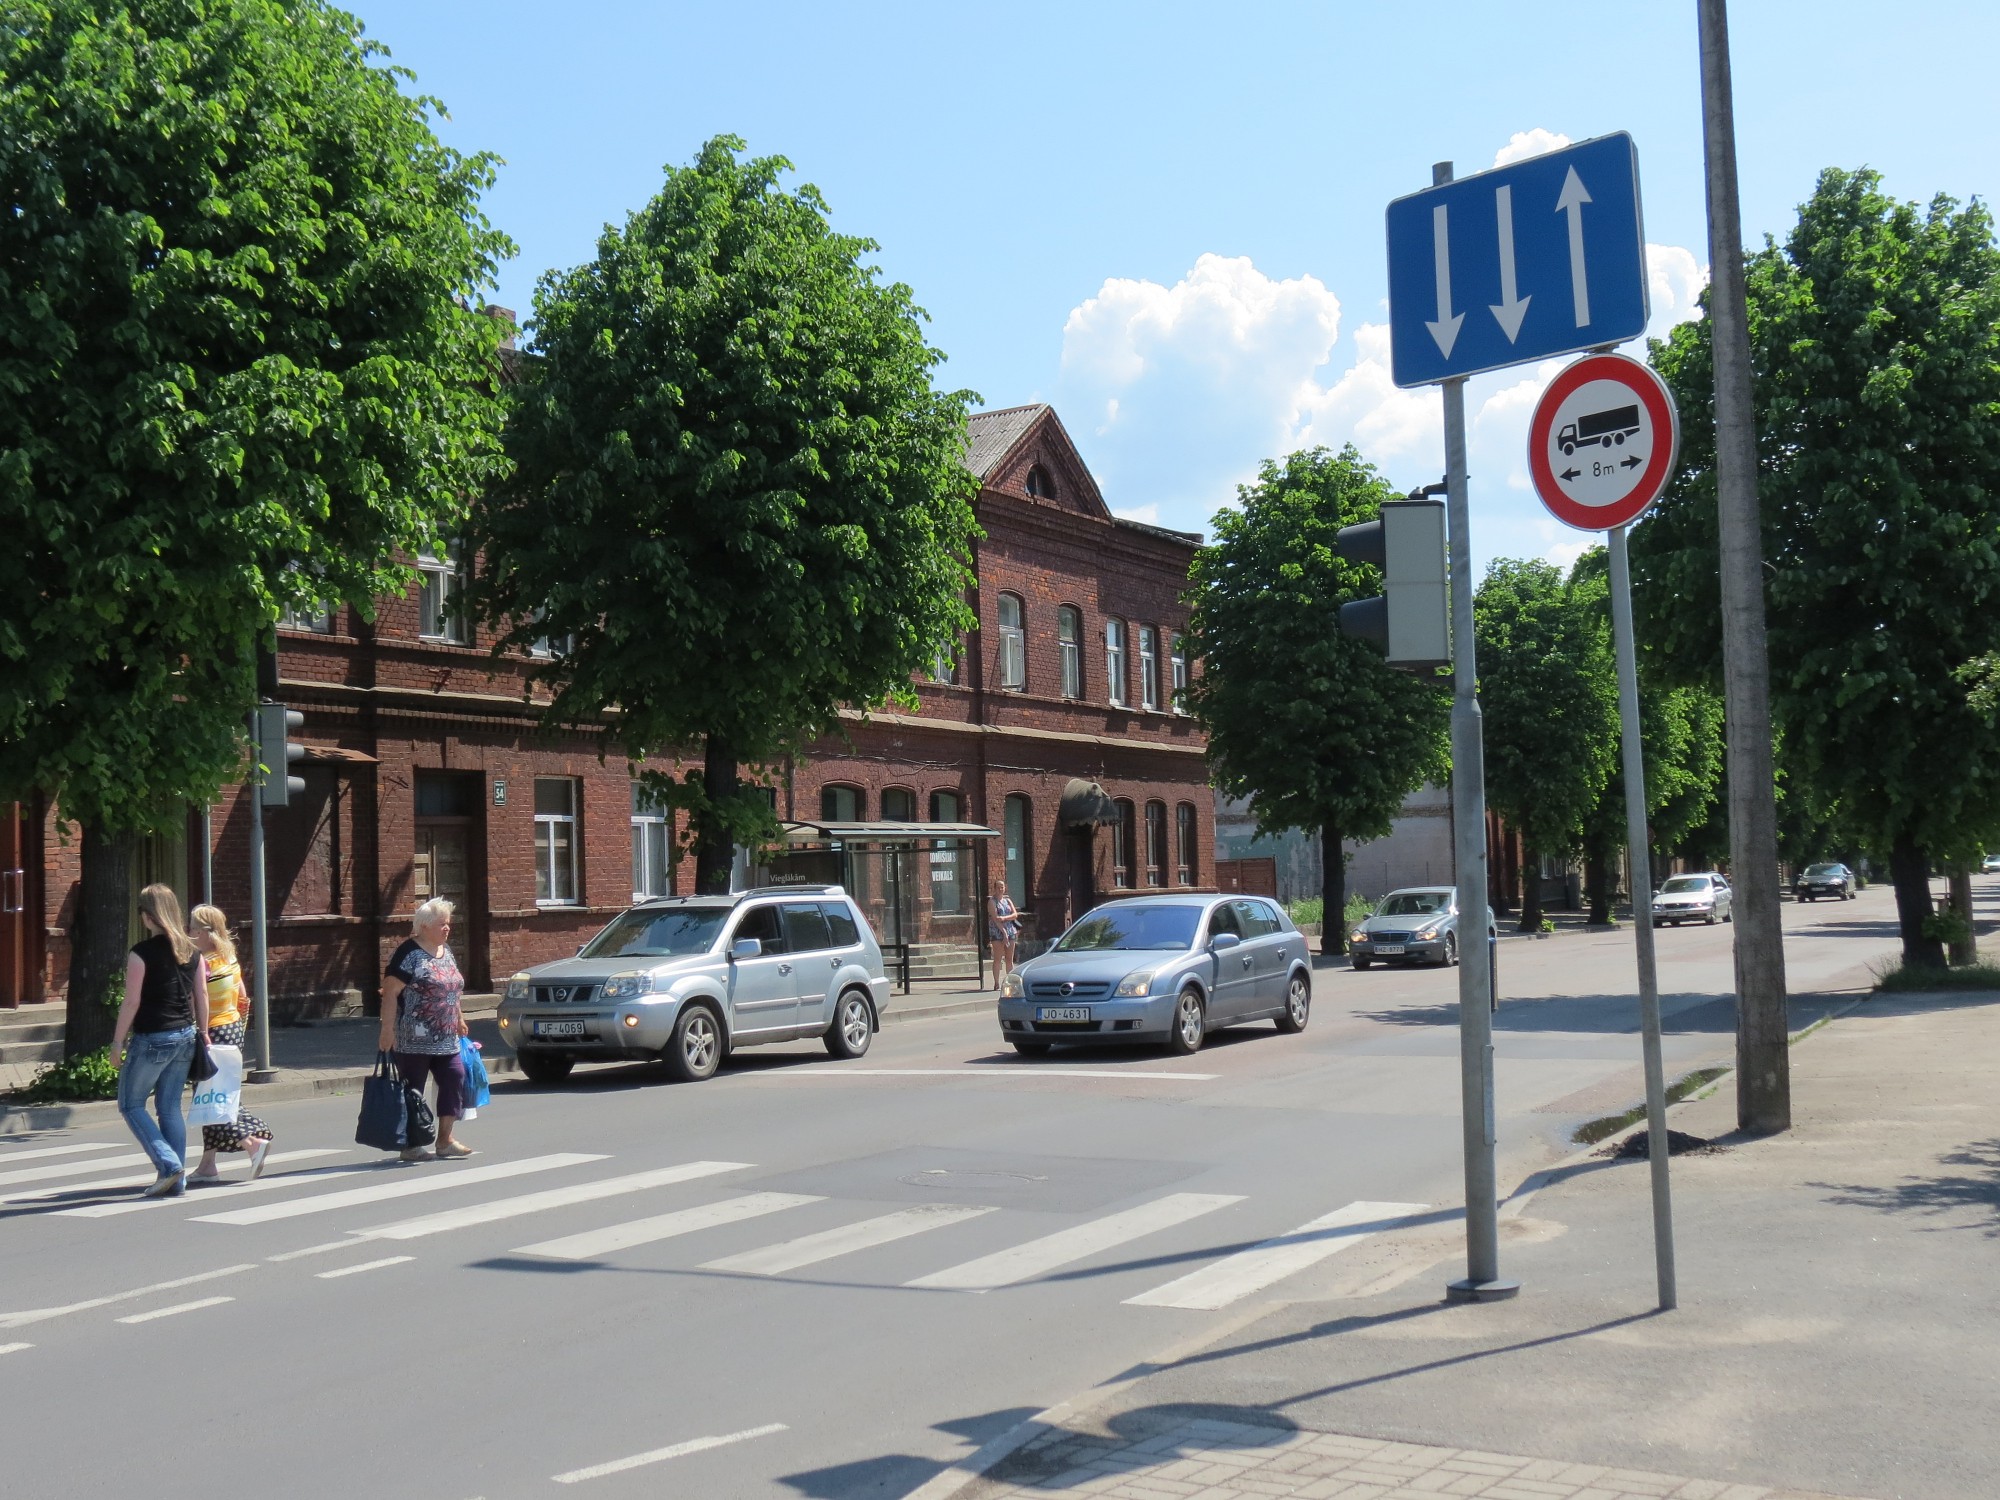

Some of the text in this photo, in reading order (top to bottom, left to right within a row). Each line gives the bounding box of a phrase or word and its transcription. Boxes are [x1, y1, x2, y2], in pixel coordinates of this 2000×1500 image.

[1593, 461, 1614, 477] 8m
[496, 788, 504, 799] 54
[931, 870, 954, 882] VEIKALS
[1043, 1009, 1088, 1019] JO-4631
[541, 1023, 583, 1034] JF-4069
